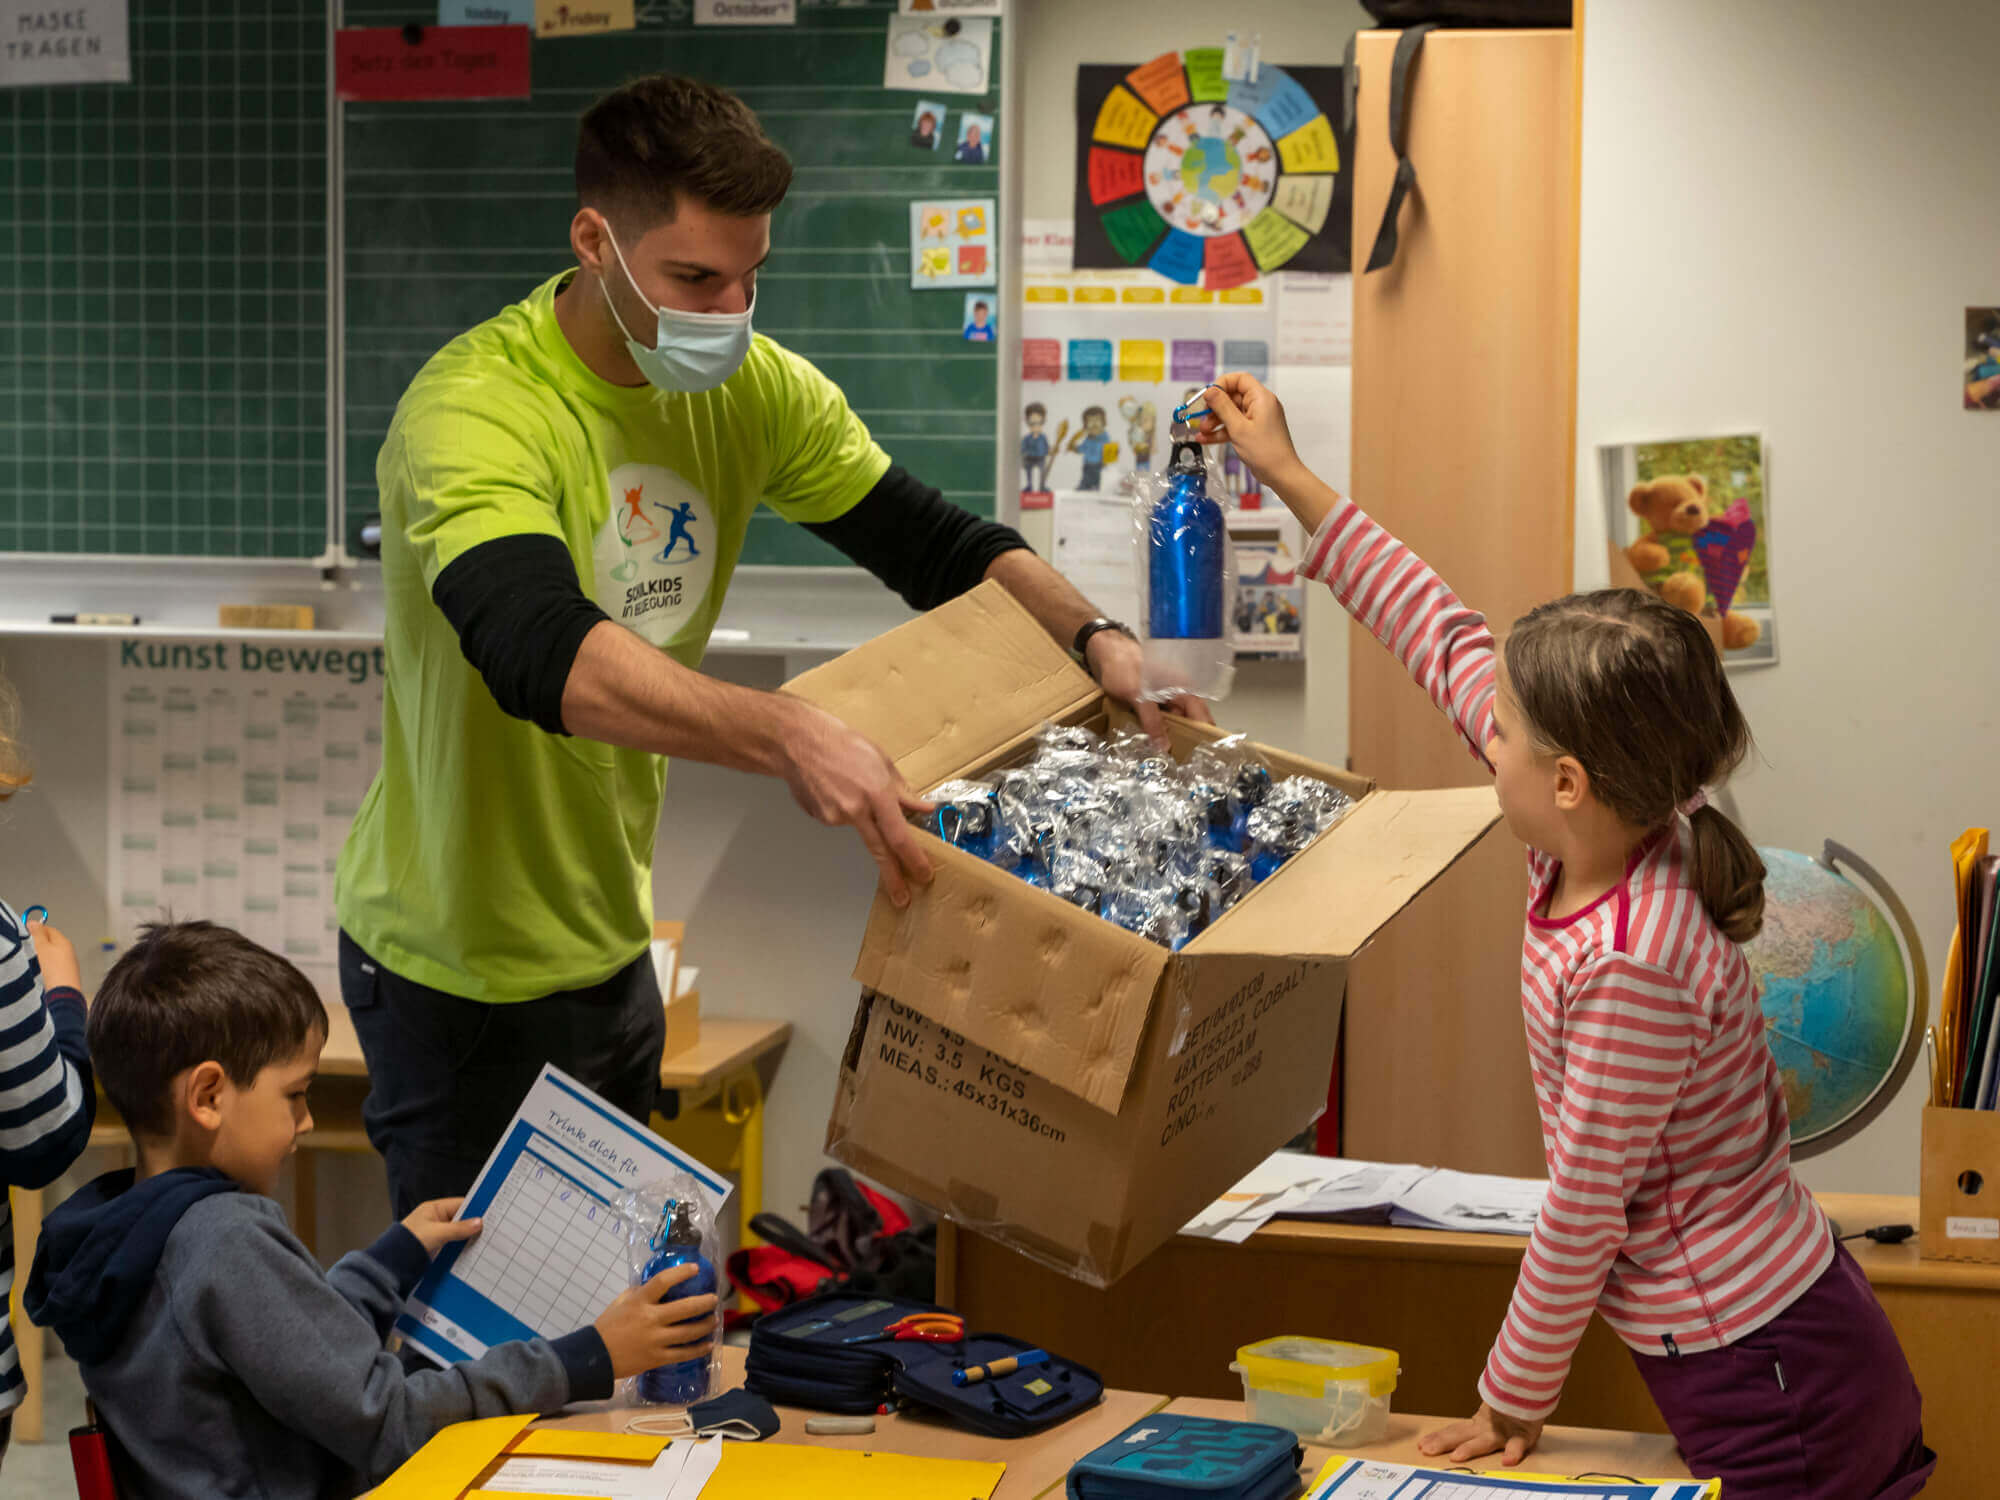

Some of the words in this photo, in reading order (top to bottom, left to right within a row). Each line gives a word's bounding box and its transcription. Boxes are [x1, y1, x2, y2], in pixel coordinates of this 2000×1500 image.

[6, 36, 102, 61] TRAGEN
[18, 8, 87, 34] MASKE
[121, 640, 229, 671] Kunst
[240, 642, 385, 684] bewegt
[1252, 961, 1307, 1020] COBALT
[884, 1019, 925, 1053] NW:
[935, 1043, 962, 1071] 3.5
[979, 1064, 1026, 1100] KGS
[1166, 1028, 1258, 1118] ROTTERDAM
[547, 1110, 587, 1144] Trink
[588, 1137, 618, 1164] dich
[619, 1157, 640, 1178] fit
